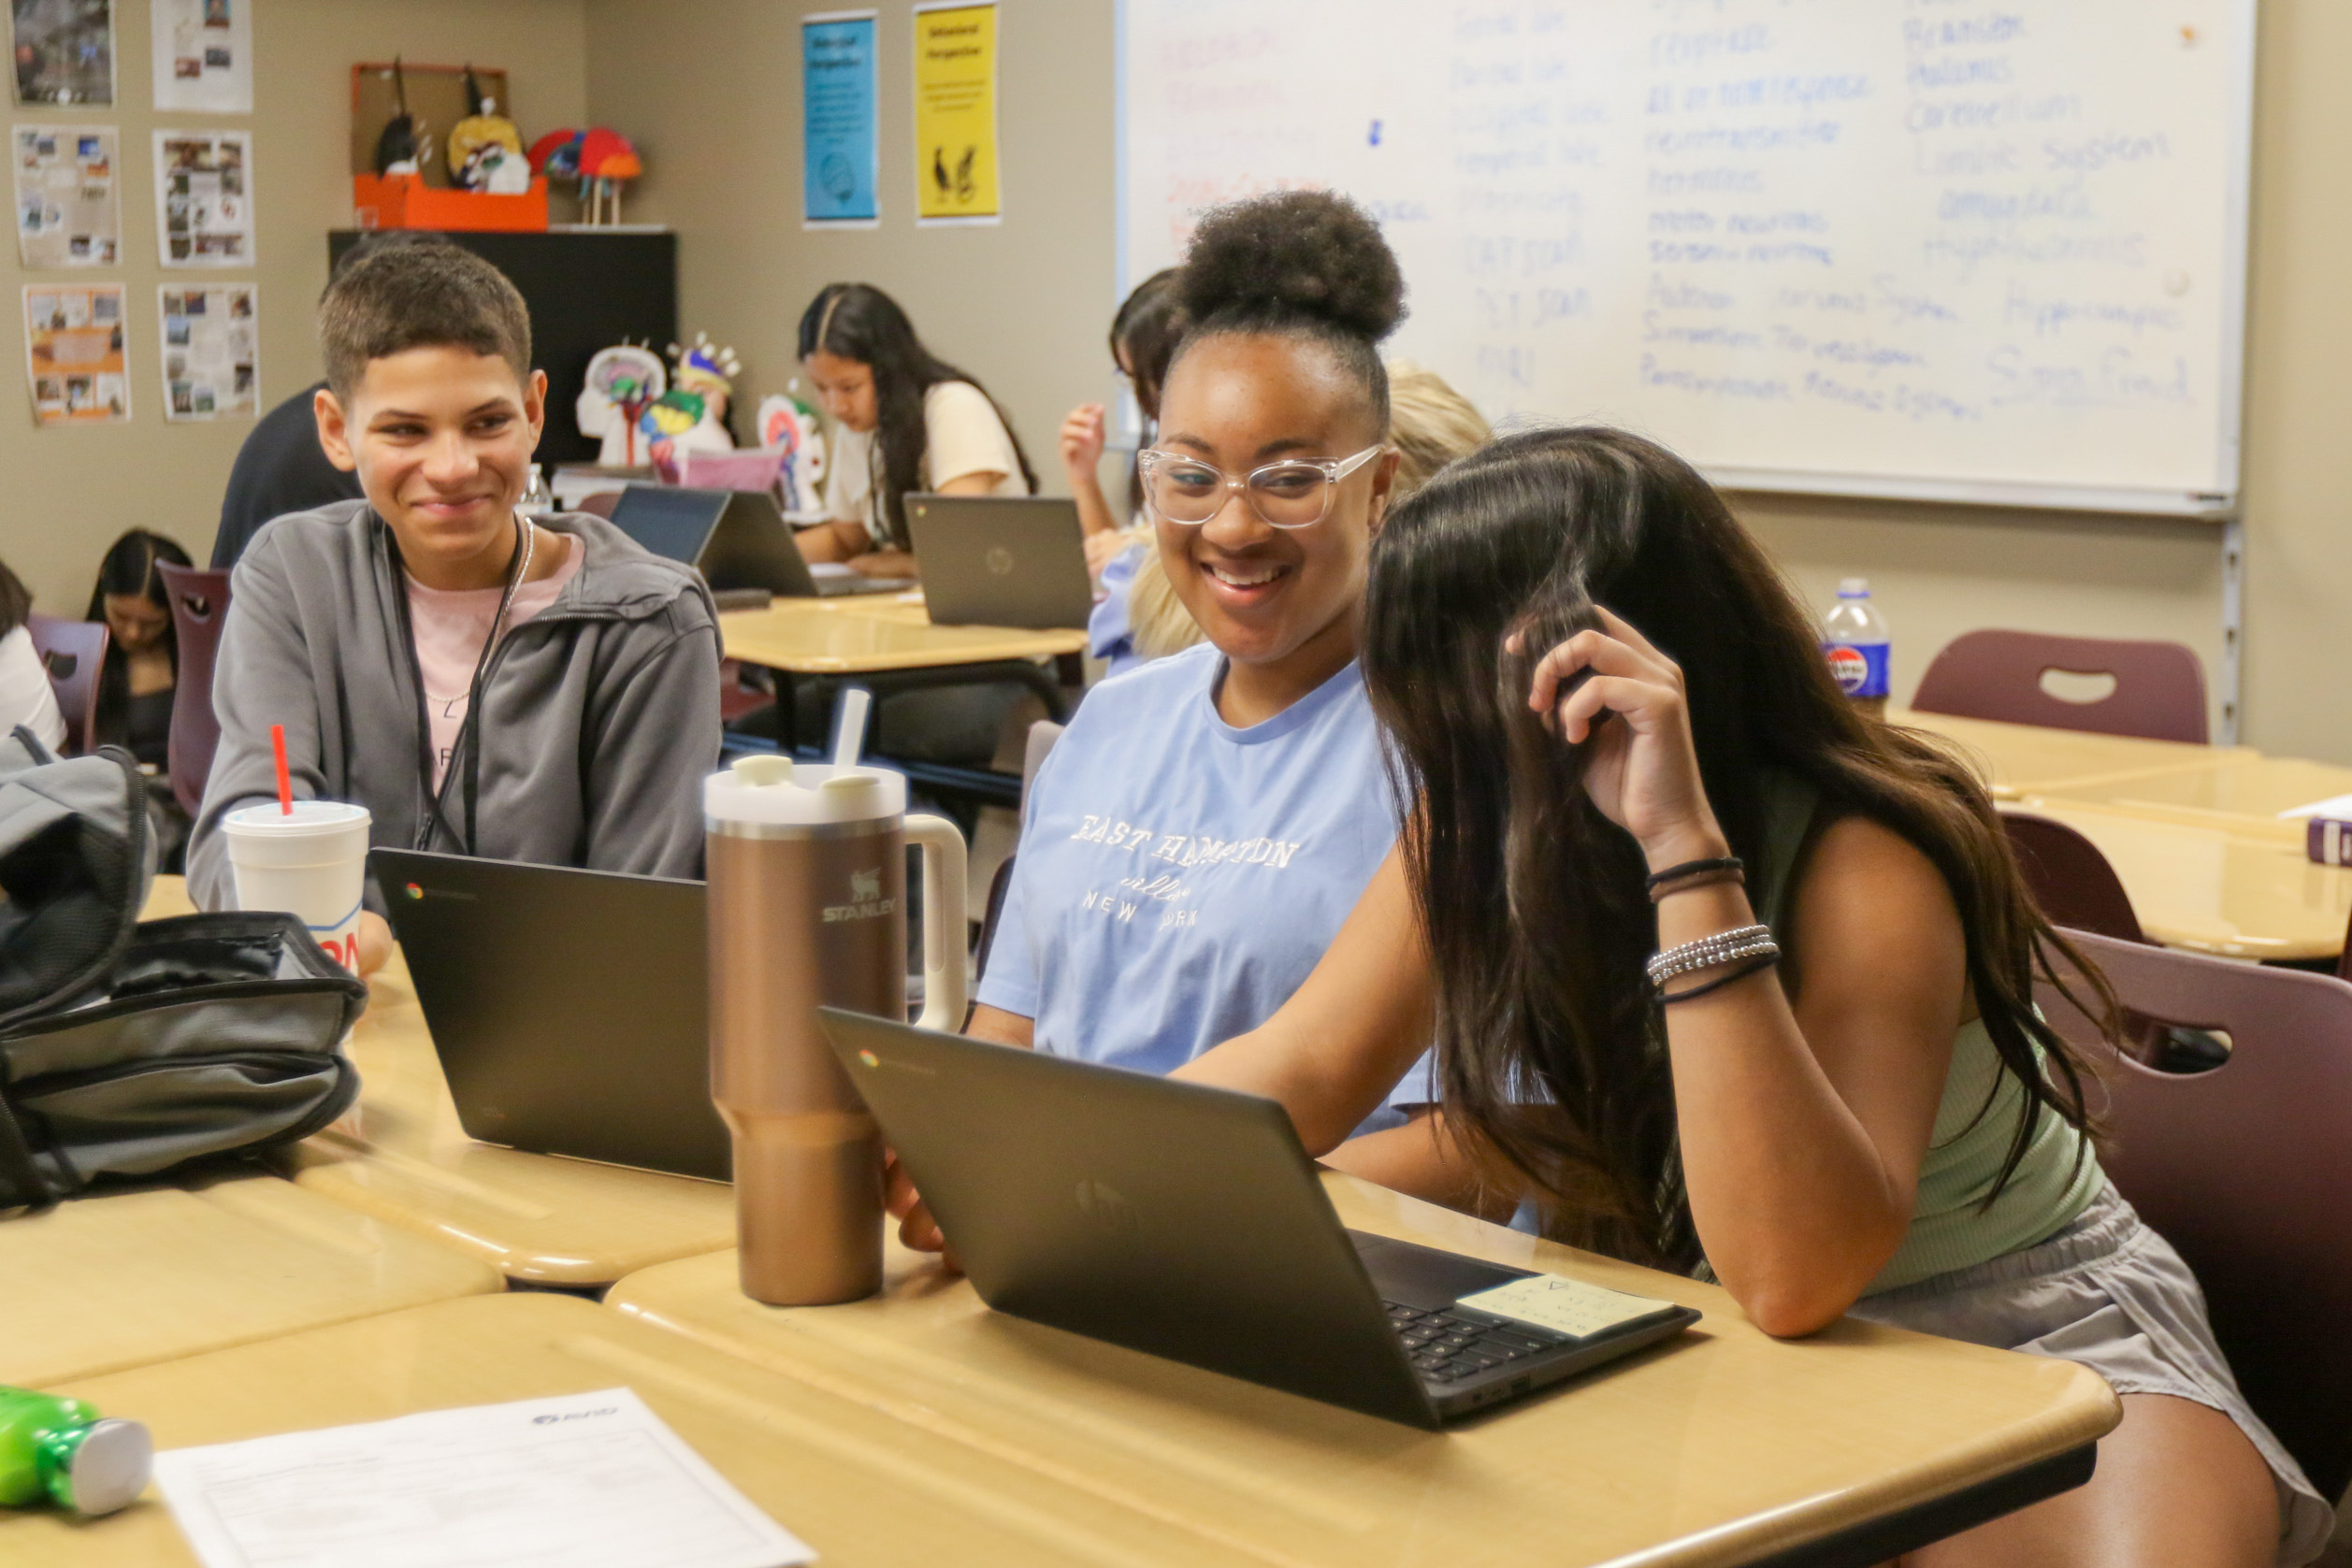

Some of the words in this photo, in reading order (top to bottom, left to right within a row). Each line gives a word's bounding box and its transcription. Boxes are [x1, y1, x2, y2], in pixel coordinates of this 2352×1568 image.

[1070, 814, 1153, 851] EAST
[822, 898, 897, 923] STANLEY
[1082, 890, 1138, 924] NEW
